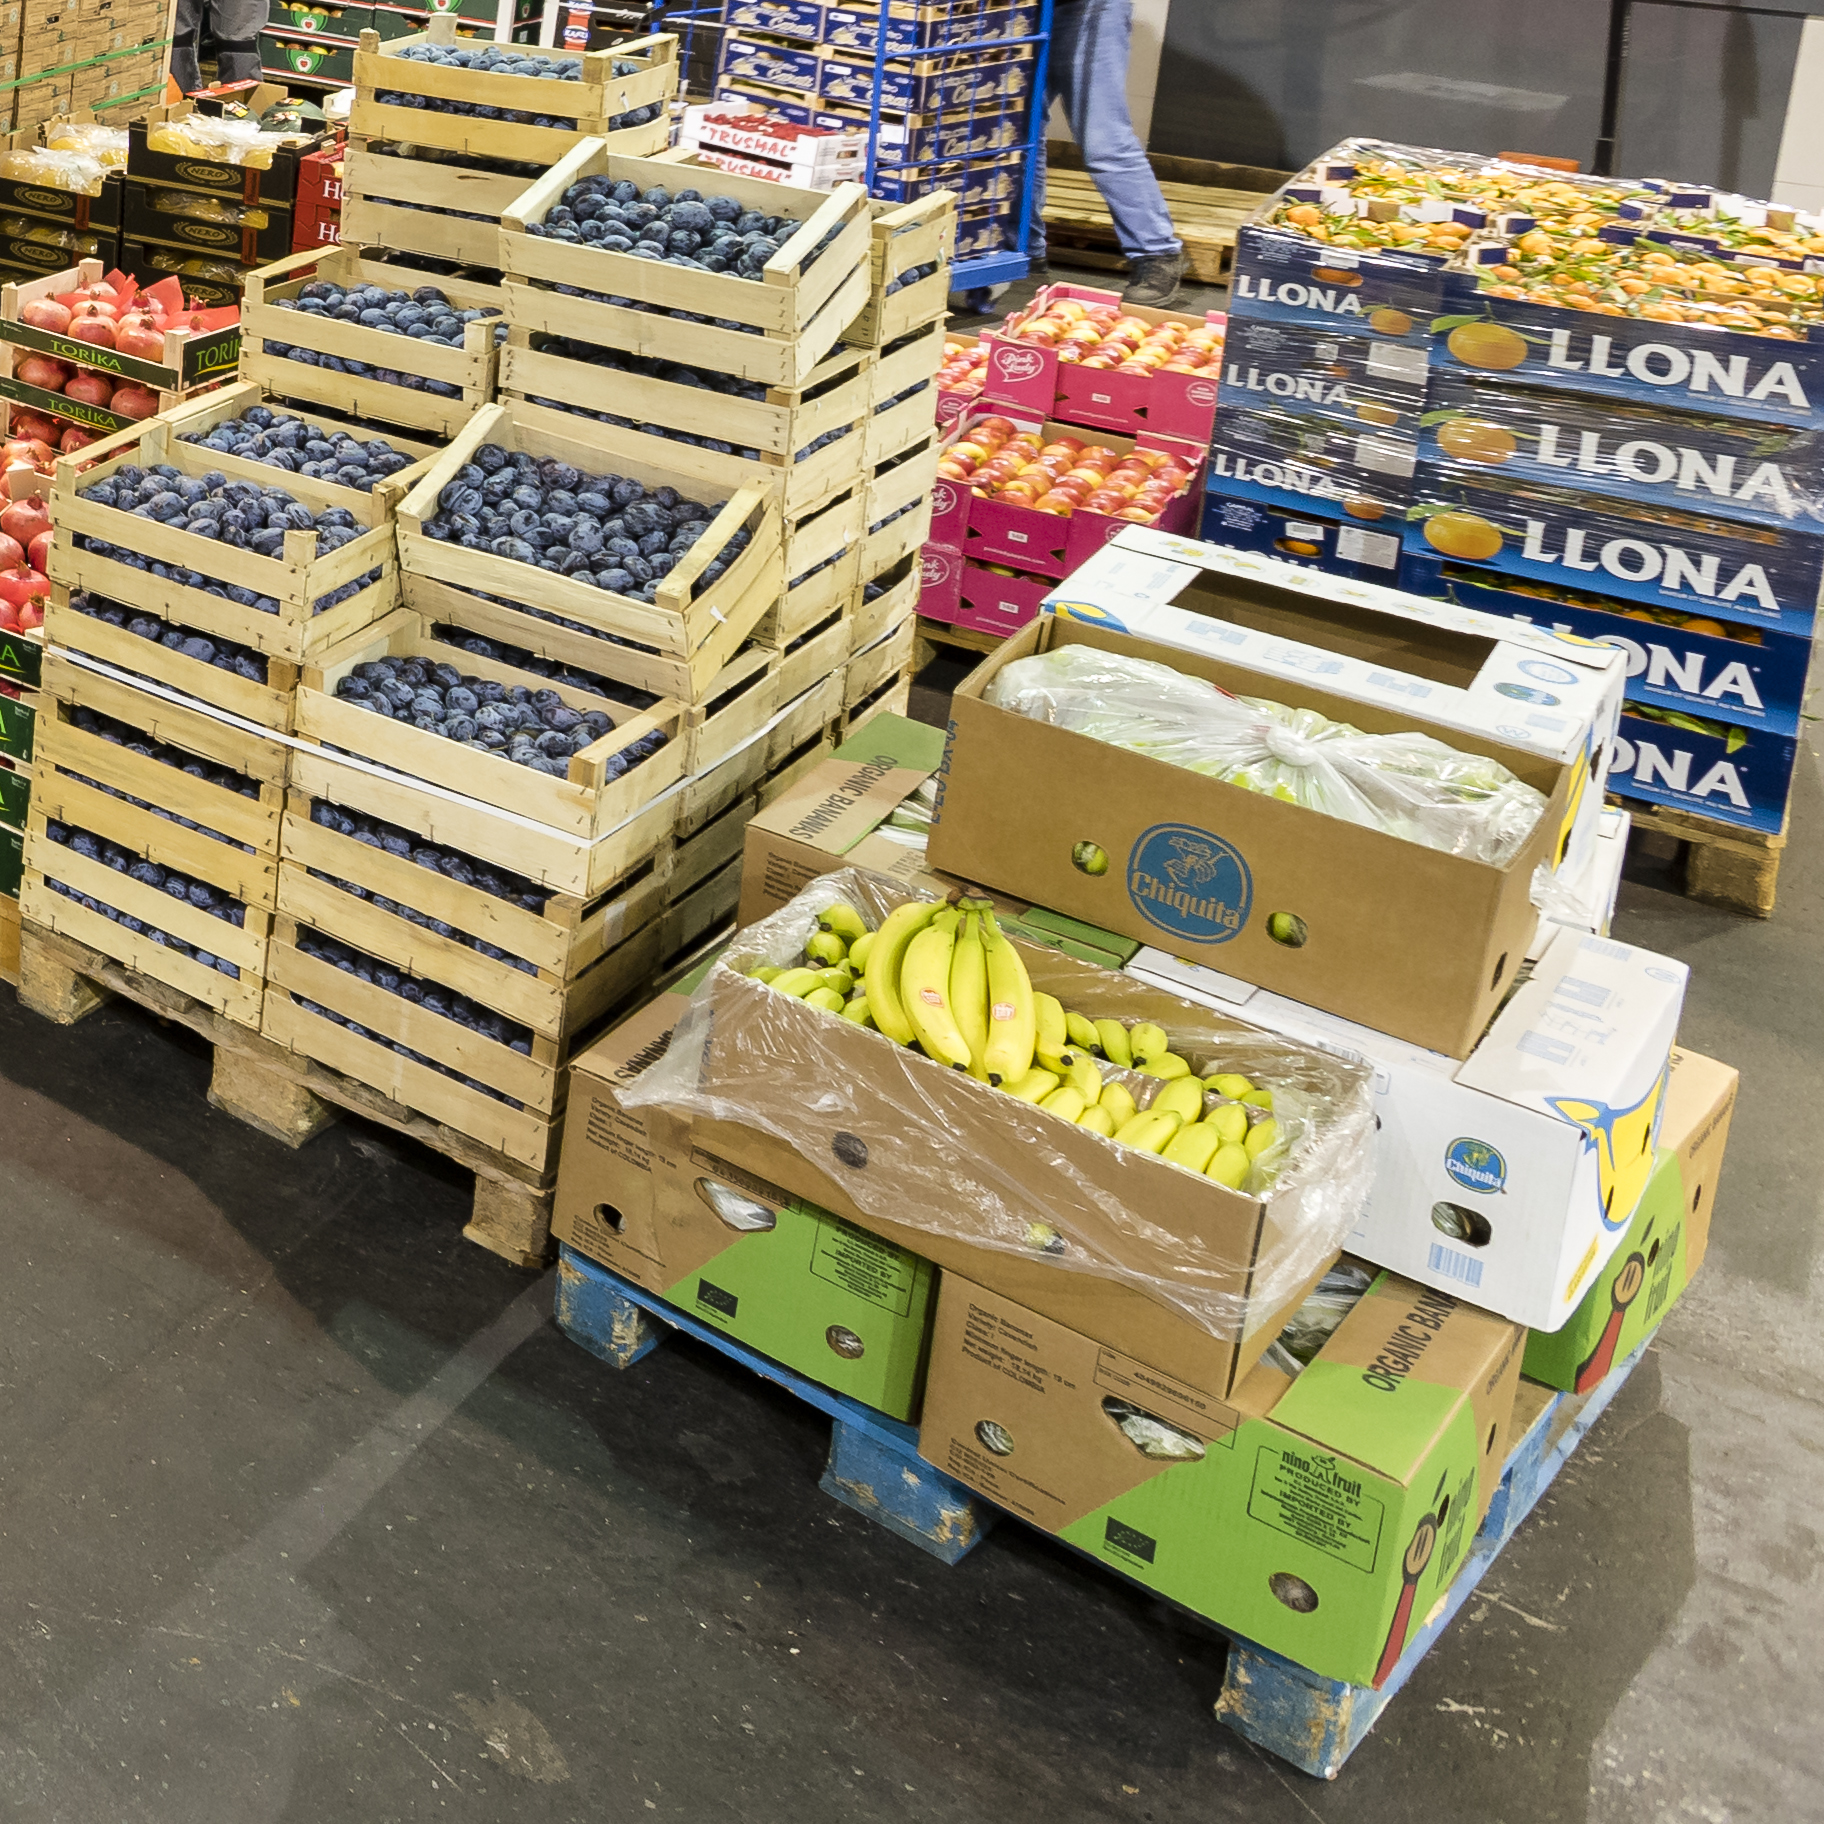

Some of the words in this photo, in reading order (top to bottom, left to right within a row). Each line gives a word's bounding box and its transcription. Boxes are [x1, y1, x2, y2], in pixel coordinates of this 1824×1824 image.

[1237, 275, 1362, 314] LLONA
[1001, 352, 1033, 365] Pink
[1008, 362, 1037, 375] Lady
[1547, 327, 1811, 409] LLONA
[1227, 364, 1352, 405] LLONA
[1214, 453, 1338, 497] LLONA
[1536, 424, 1795, 517] LLONA
[1593, 634, 1765, 710] ONA
[841, 754, 898, 797] ORGANIC
[789, 793, 856, 840] BANANAS
[1131, 872, 1240, 930] Chiquita
[1446, 1157, 1505, 1188] Chiquita
[1362, 1324, 1432, 1392] ORGANIC
[1420, 1290, 1459, 1334] BANA
[1279, 1464, 1342, 1500] PRODUCED
[1345, 1495, 1360, 1507] BY
[1280, 1490, 1335, 1522] IMPORTED
[1336, 1516, 1352, 1528] BY
